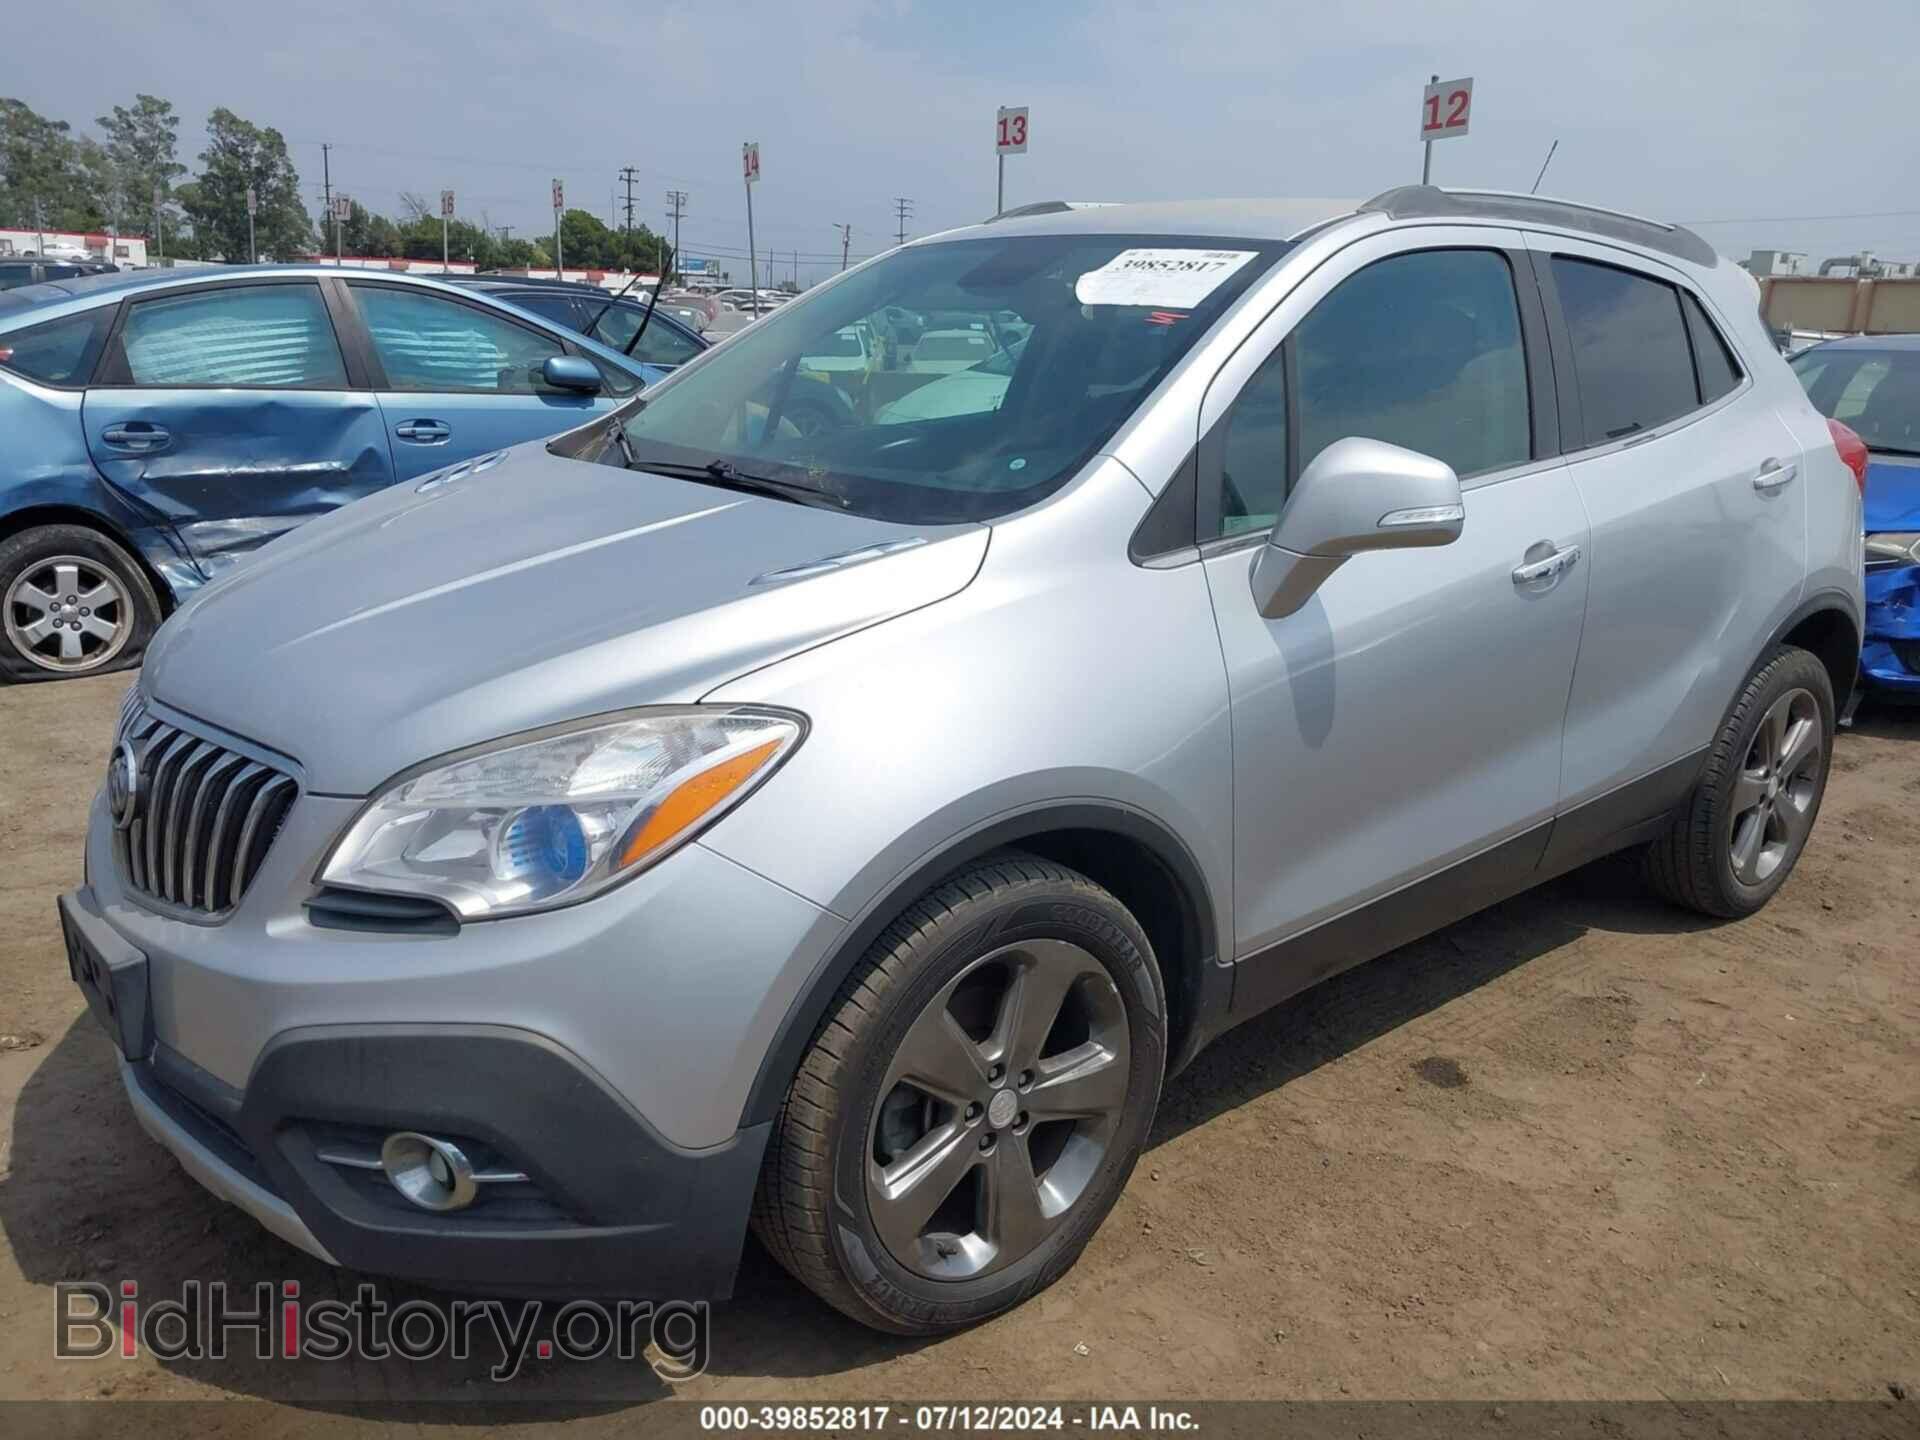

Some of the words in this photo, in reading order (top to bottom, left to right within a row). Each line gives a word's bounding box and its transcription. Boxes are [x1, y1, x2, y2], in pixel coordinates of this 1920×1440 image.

[1423, 90, 1469, 131] 12
[998, 116, 1027, 147] 13
[743, 150, 760, 178] 14
[441, 195, 456, 216] 16
[1115, 259, 1227, 273] 39852817
